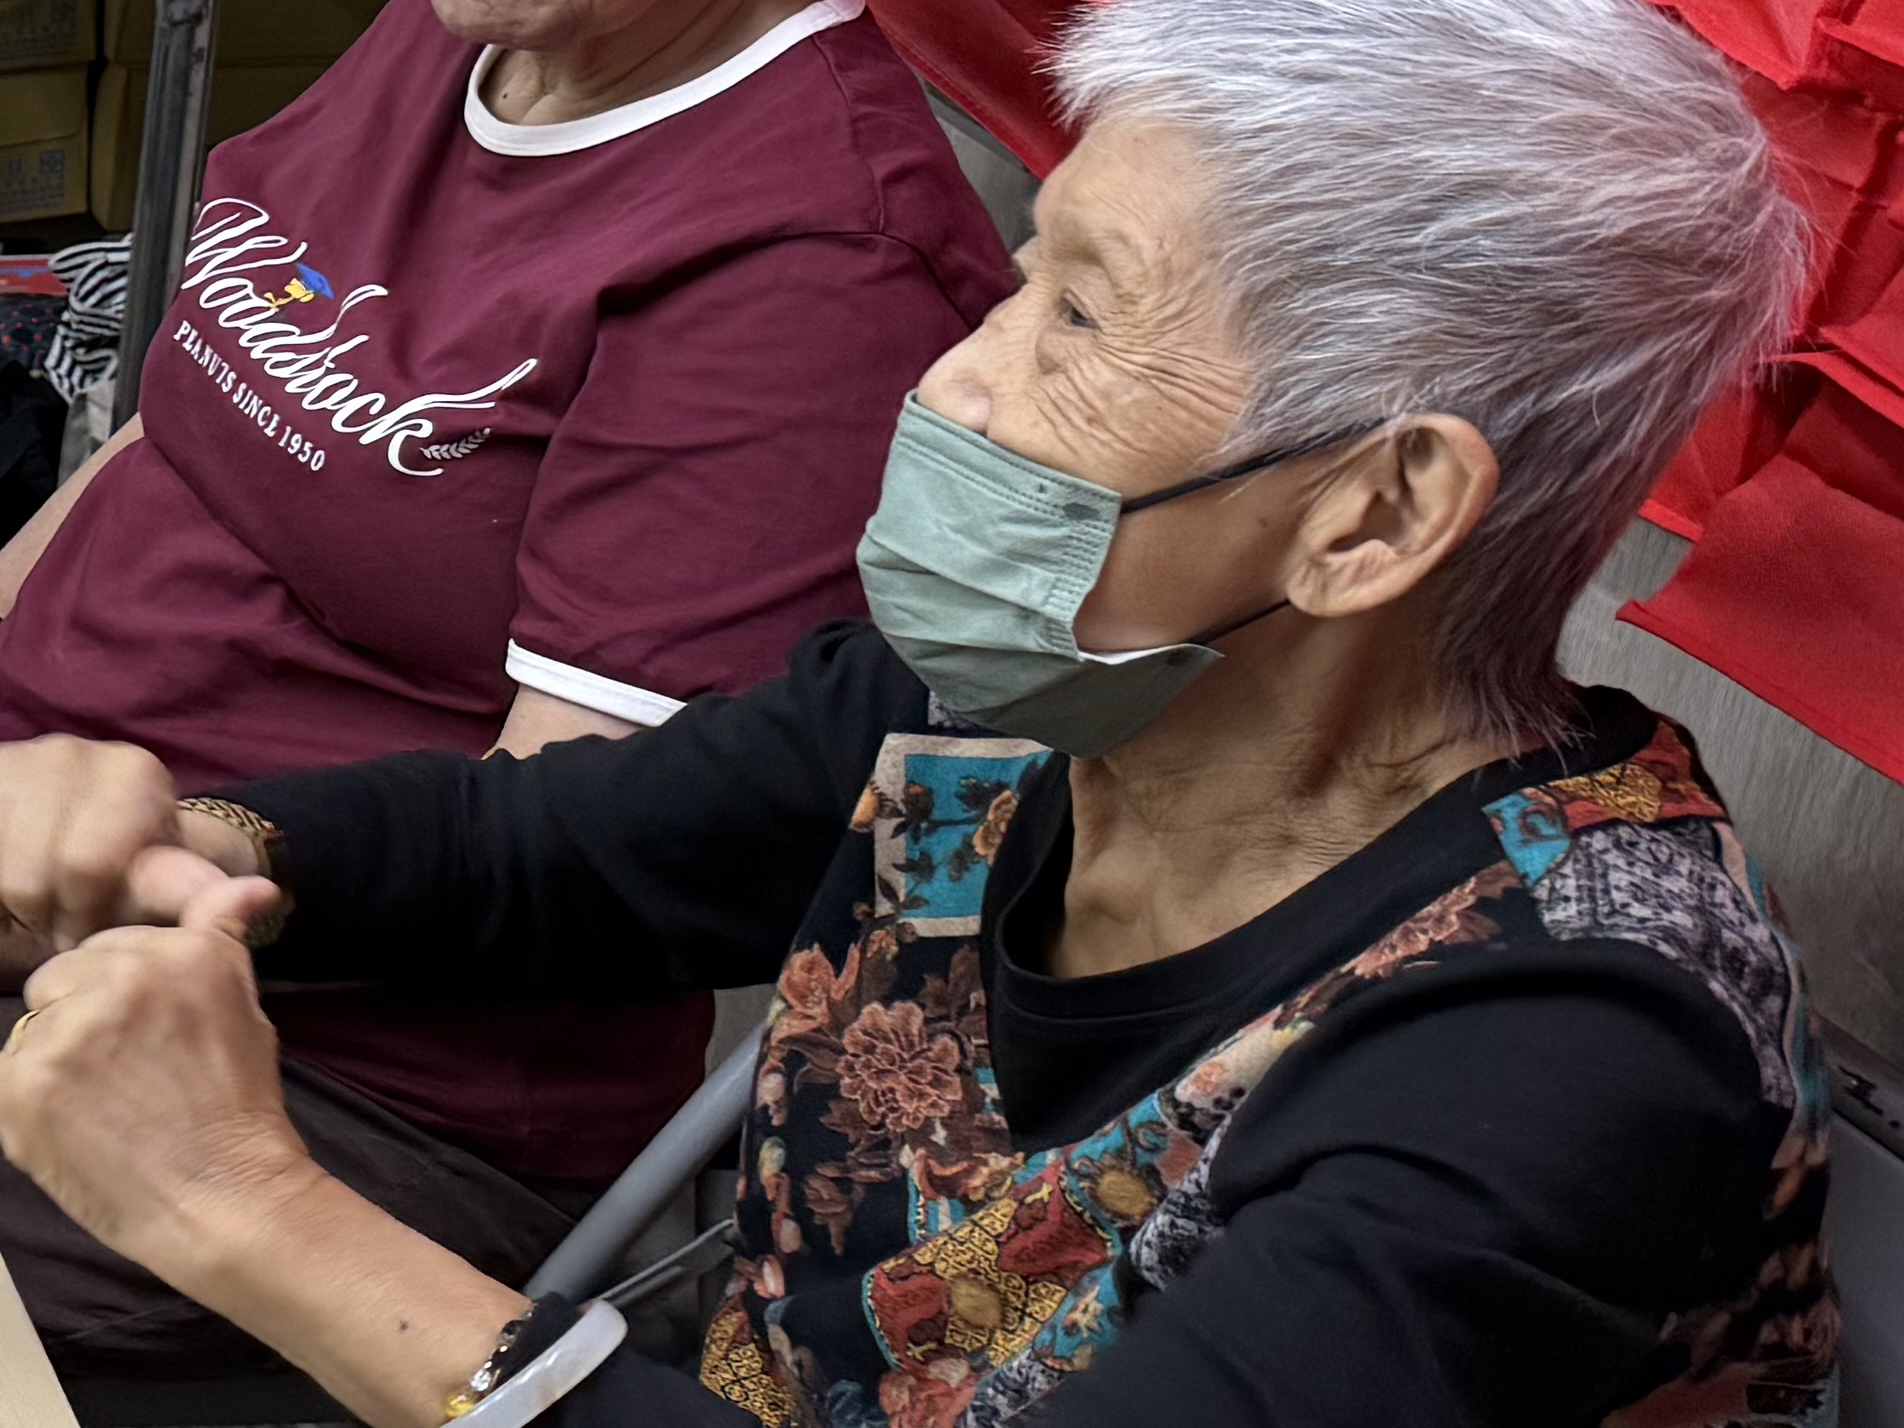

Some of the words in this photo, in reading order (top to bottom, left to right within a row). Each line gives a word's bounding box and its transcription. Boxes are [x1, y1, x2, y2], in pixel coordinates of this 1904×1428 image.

[173, 320, 237, 393] PEANUTS
[232, 382, 278, 438] SINCE
[277, 426, 326, 472] 1950
[180, 197, 539, 476] Woodstock
